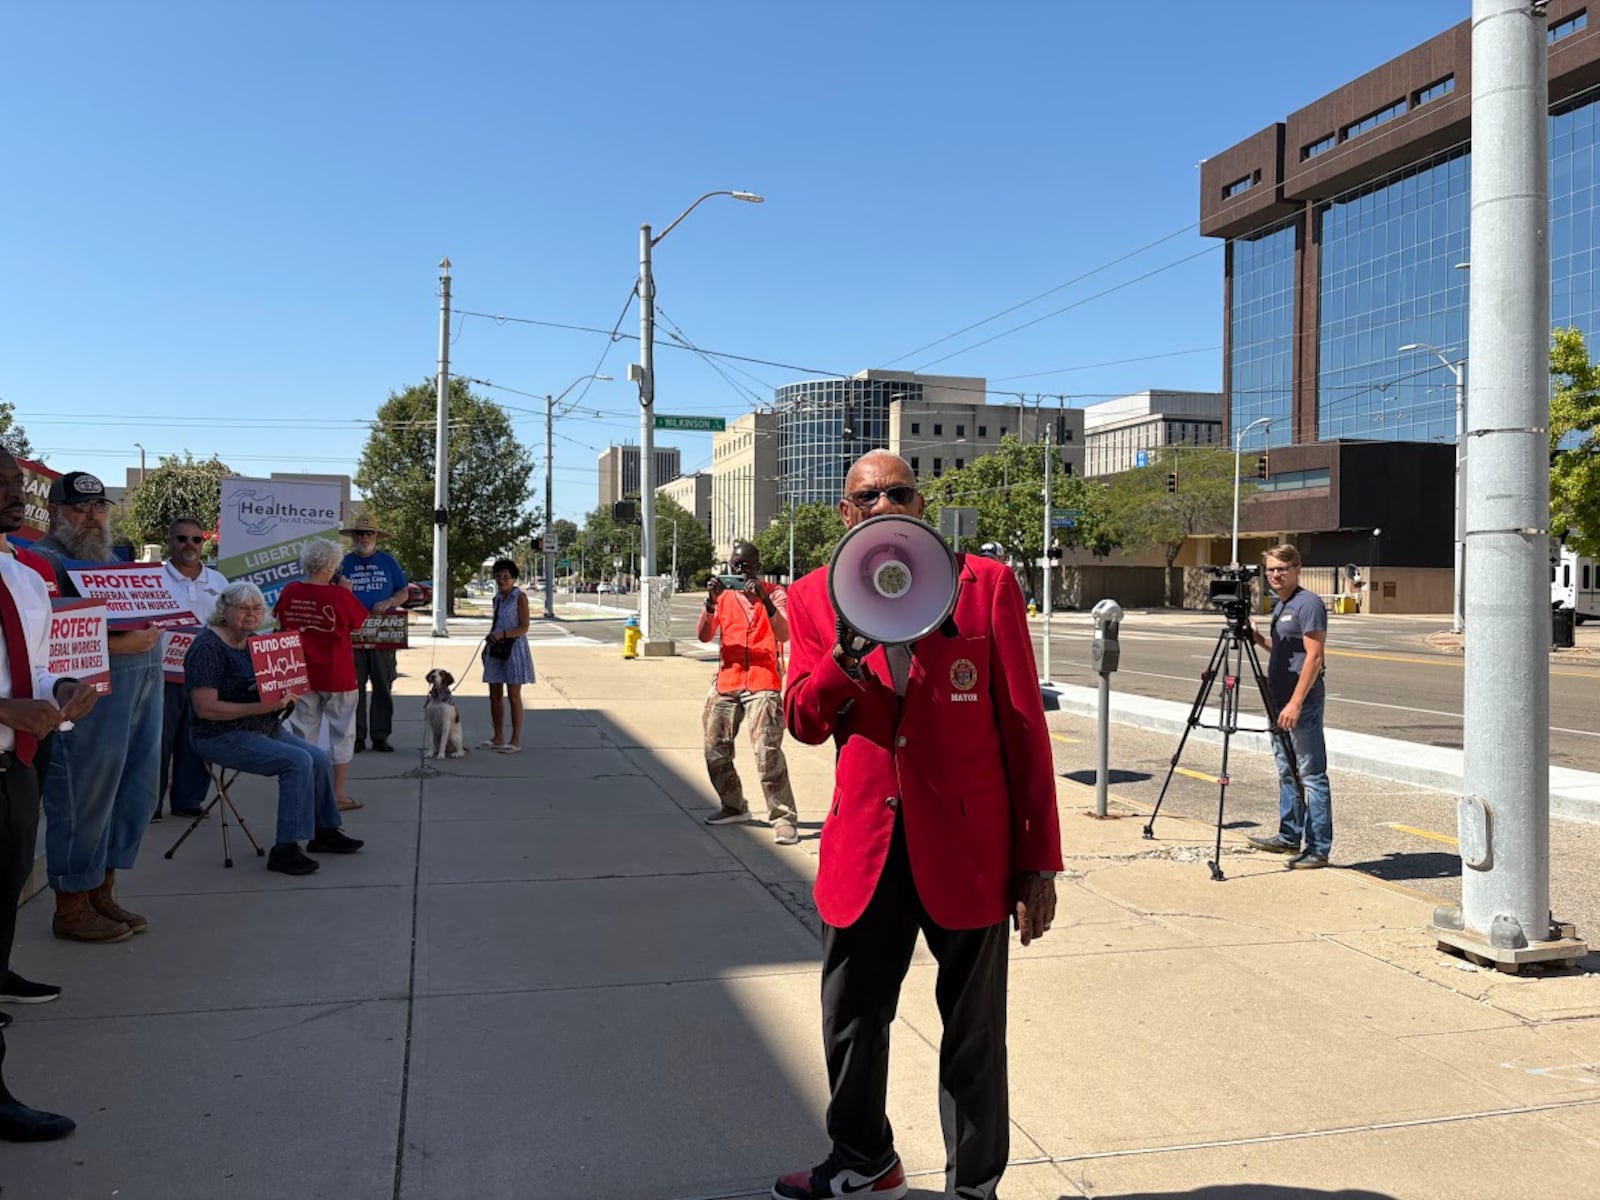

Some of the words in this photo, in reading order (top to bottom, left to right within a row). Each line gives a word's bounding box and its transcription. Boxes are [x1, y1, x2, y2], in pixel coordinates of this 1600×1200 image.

[664, 417, 710, 429] WILKINSON
[25, 503, 37, 517] OT
[241, 501, 335, 519] Healthcare
[235, 561, 305, 586] USTICE,
[80, 574, 163, 588] PROTECT
[366, 582, 383, 592] ALL!
[90, 590, 129, 601] FEDERAL
[129, 590, 172, 600] WORKERS
[134, 601, 146, 611] VA
[148, 600, 180, 610] NURSES
[49, 617, 102, 640] ROTECT
[49, 641, 70, 657] DERAL
[71, 639, 101, 655] WORKERS
[252, 637, 279, 654] FUND
[280, 635, 301, 649] CARE
[80, 655, 103, 669] NURSES
[261, 679, 277, 693] NOT
[951, 693, 978, 702] MAYOR
